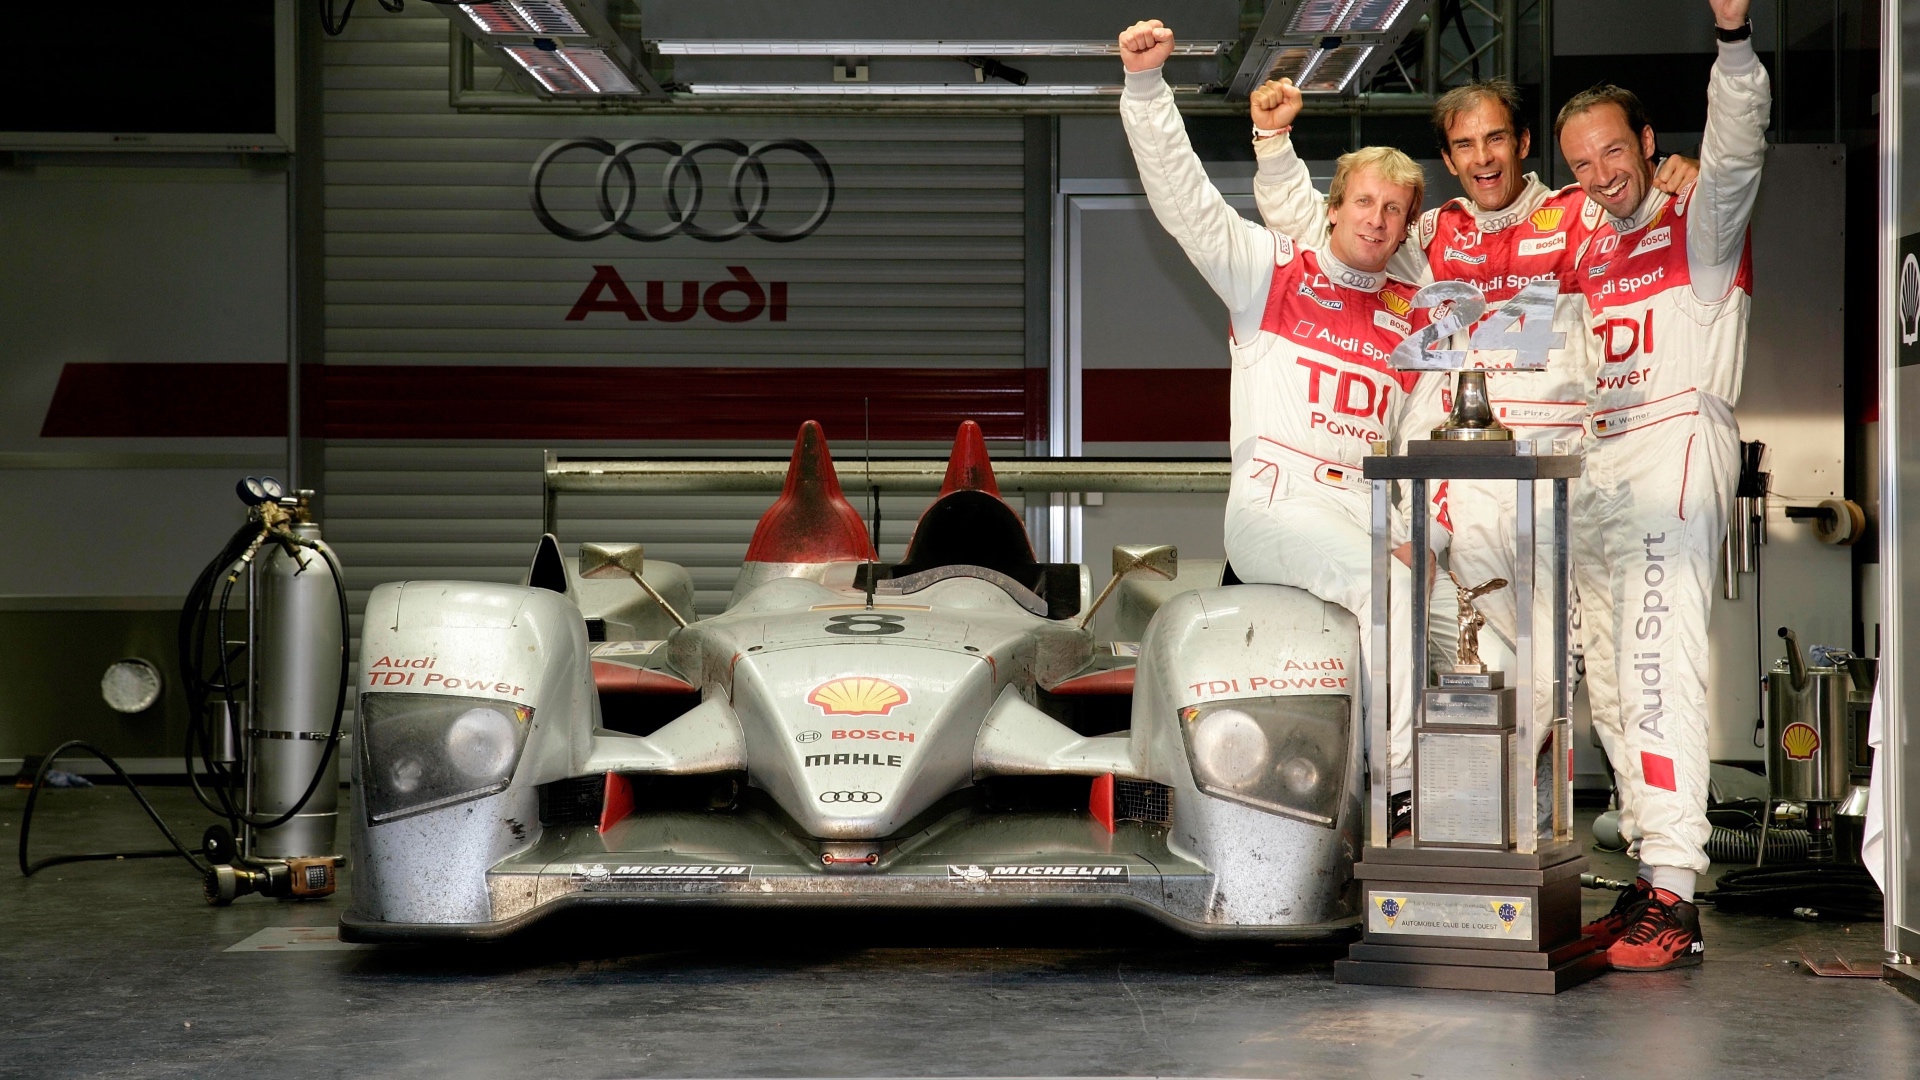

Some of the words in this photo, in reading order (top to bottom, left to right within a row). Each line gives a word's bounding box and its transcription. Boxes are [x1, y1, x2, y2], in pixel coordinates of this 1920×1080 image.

[1535, 236, 1564, 249] BOSCH
[1641, 232, 1670, 247] BOSCH
[1619, 266, 1664, 292] Sport
[565, 265, 787, 322] Audi
[1387, 280, 1567, 369] 24
[1316, 328, 1359, 352] Audi
[1361, 342, 1391, 362] Spo
[1296, 356, 1392, 426] TDI
[1619, 412, 1650, 424] Werner
[1635, 532, 1669, 640] Sport
[825, 614, 905, 635] 8
[372, 656, 437, 669] Audi
[1284, 658, 1344, 671] Audi
[368, 672, 415, 686] TDI
[423, 673, 524, 696] Power
[1189, 679, 1239, 697] TDI
[1250, 677, 1348, 691] Power
[1634, 652, 1665, 740] Audi
[831, 729, 915, 742] BOSCH
[805, 753, 902, 767] MAHLE
[614, 866, 747, 874] MICHELIN
[992, 866, 1122, 875] MICHELIN
